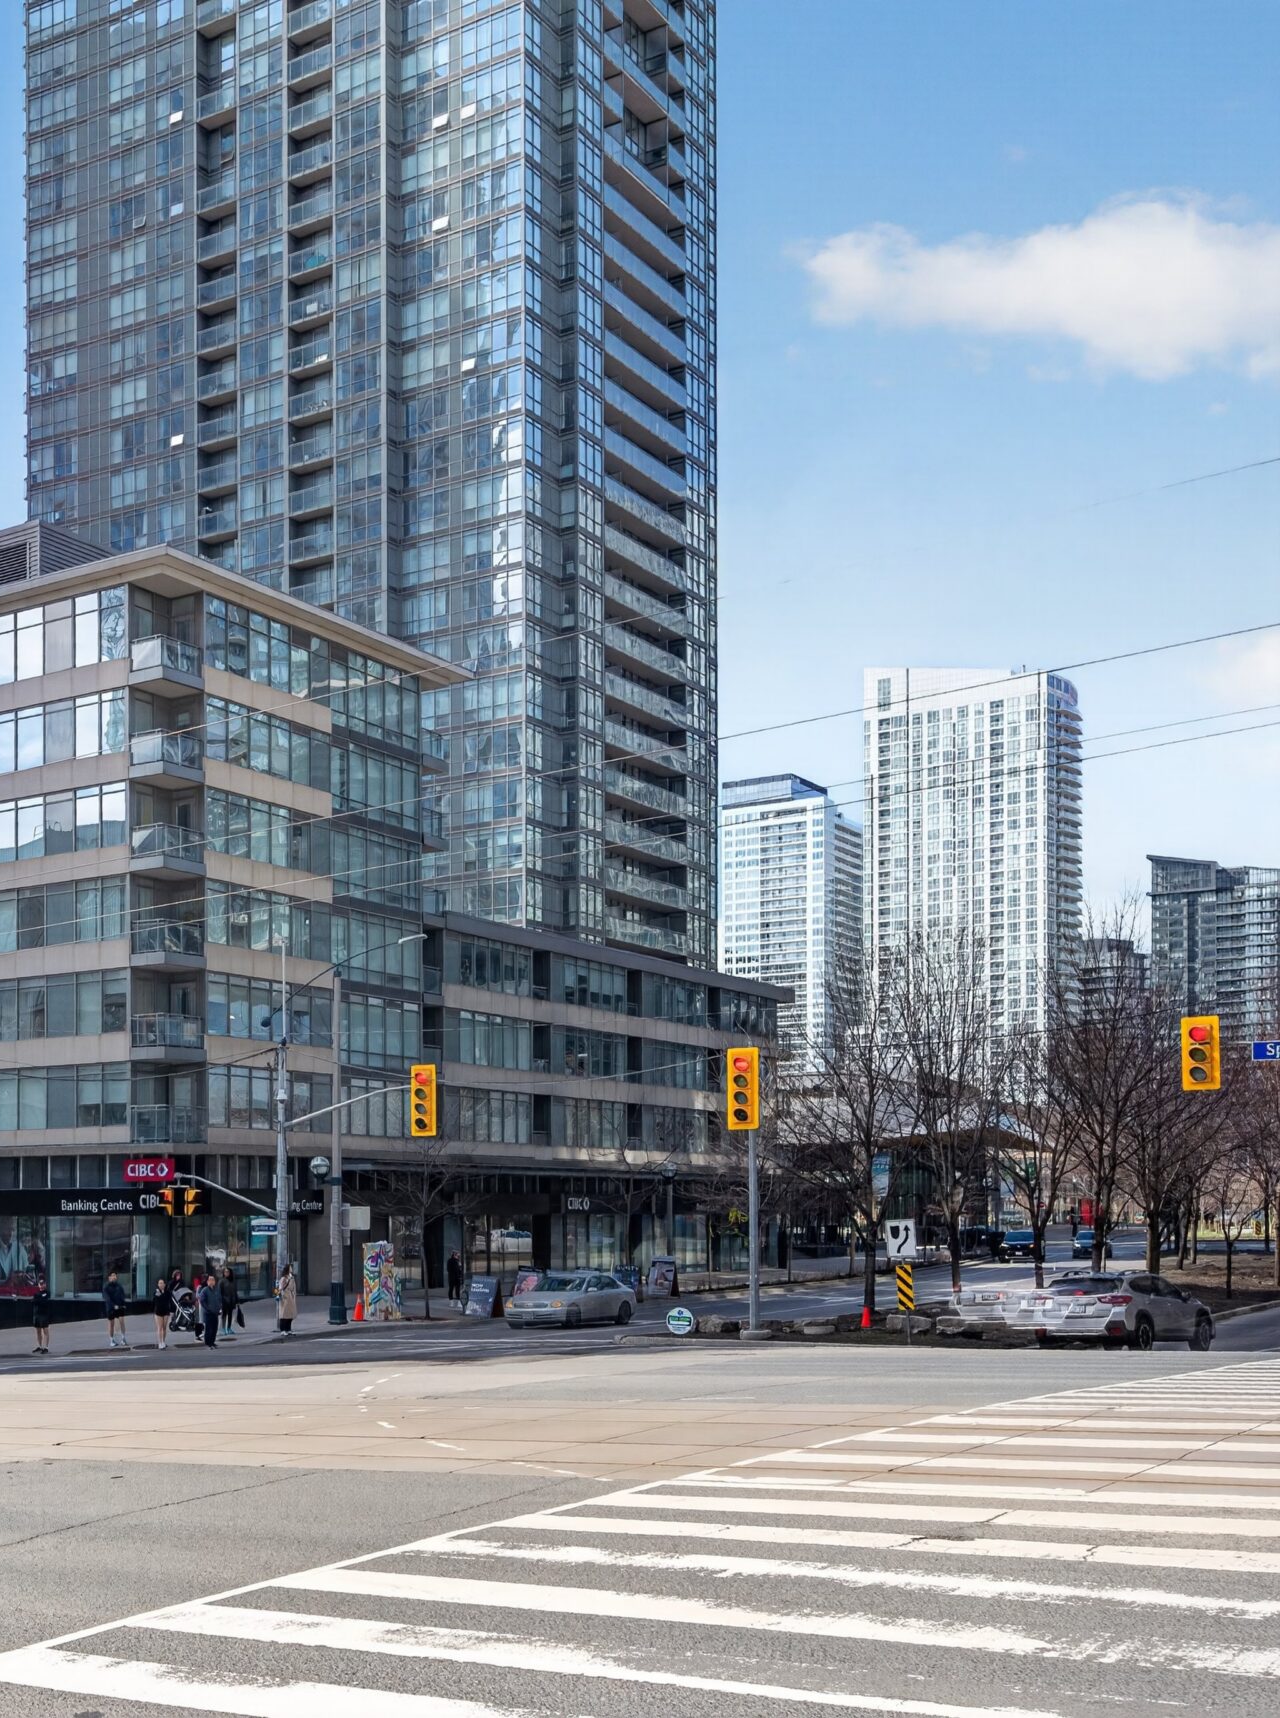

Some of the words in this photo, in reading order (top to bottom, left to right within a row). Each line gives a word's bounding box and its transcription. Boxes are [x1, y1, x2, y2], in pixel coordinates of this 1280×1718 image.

[127, 1163, 155, 1177] CIBC
[61, 1199, 99, 1213] Banking
[100, 1199, 133, 1211] Centre
[301, 1199, 323, 1211] Centre
